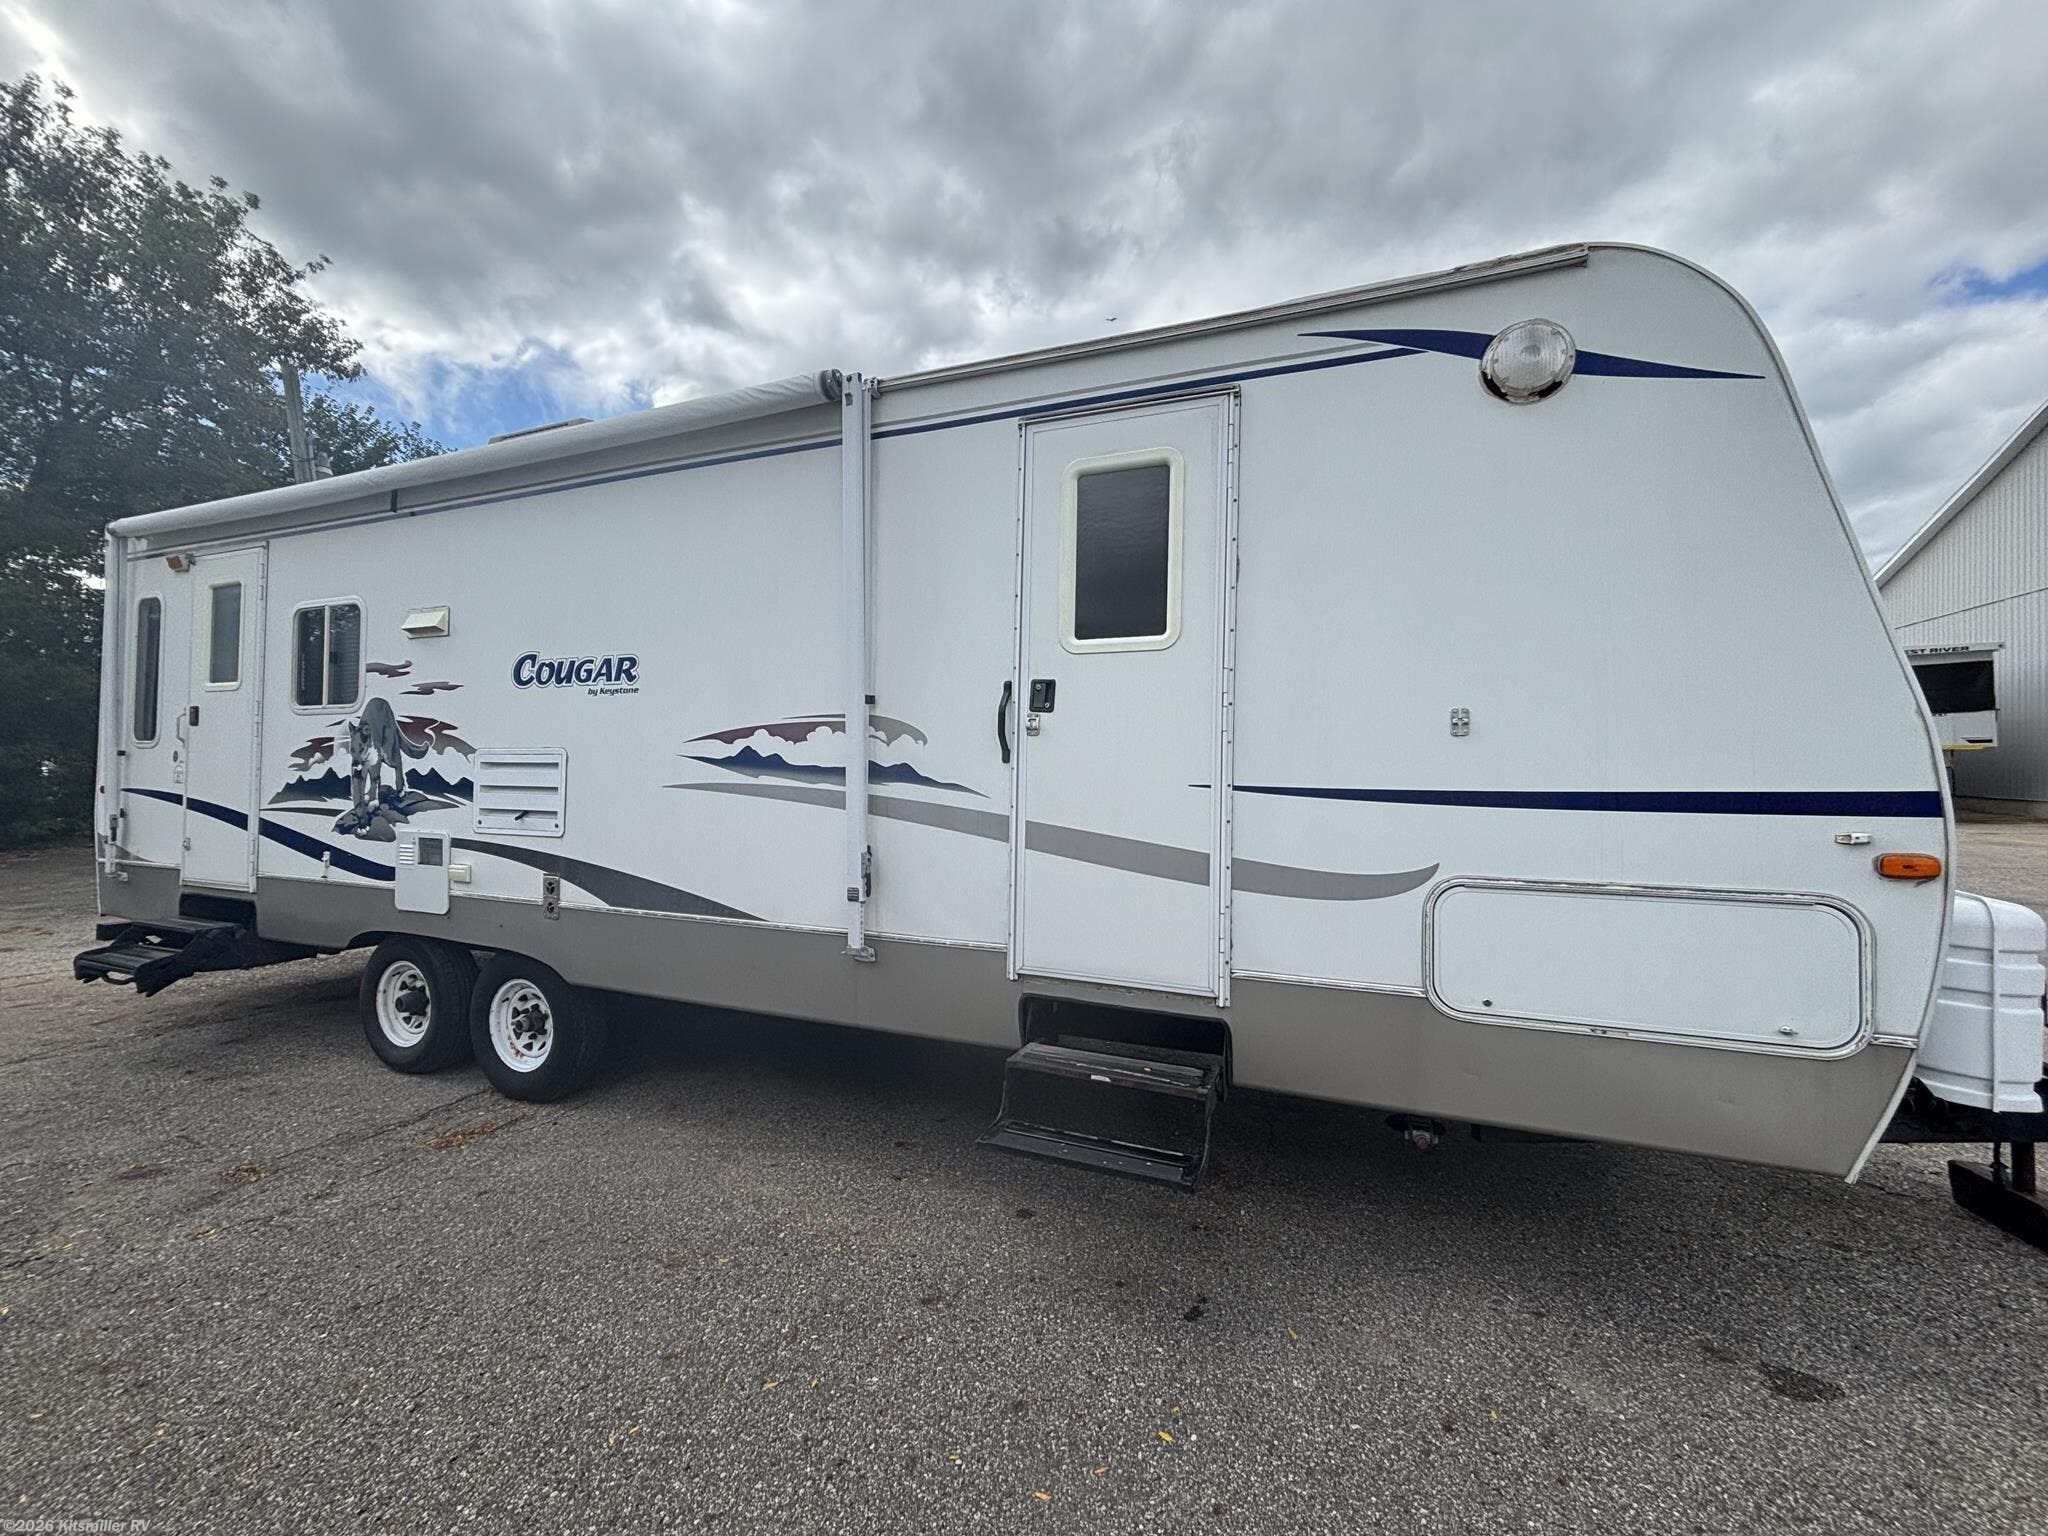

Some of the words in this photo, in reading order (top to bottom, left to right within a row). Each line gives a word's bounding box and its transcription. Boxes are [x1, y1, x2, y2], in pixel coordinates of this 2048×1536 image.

[1930, 645, 1969, 653] RIVER
[512, 652, 639, 688] COUGAR
[587, 687, 598, 696] by
[600, 687, 640, 696] Keystone
